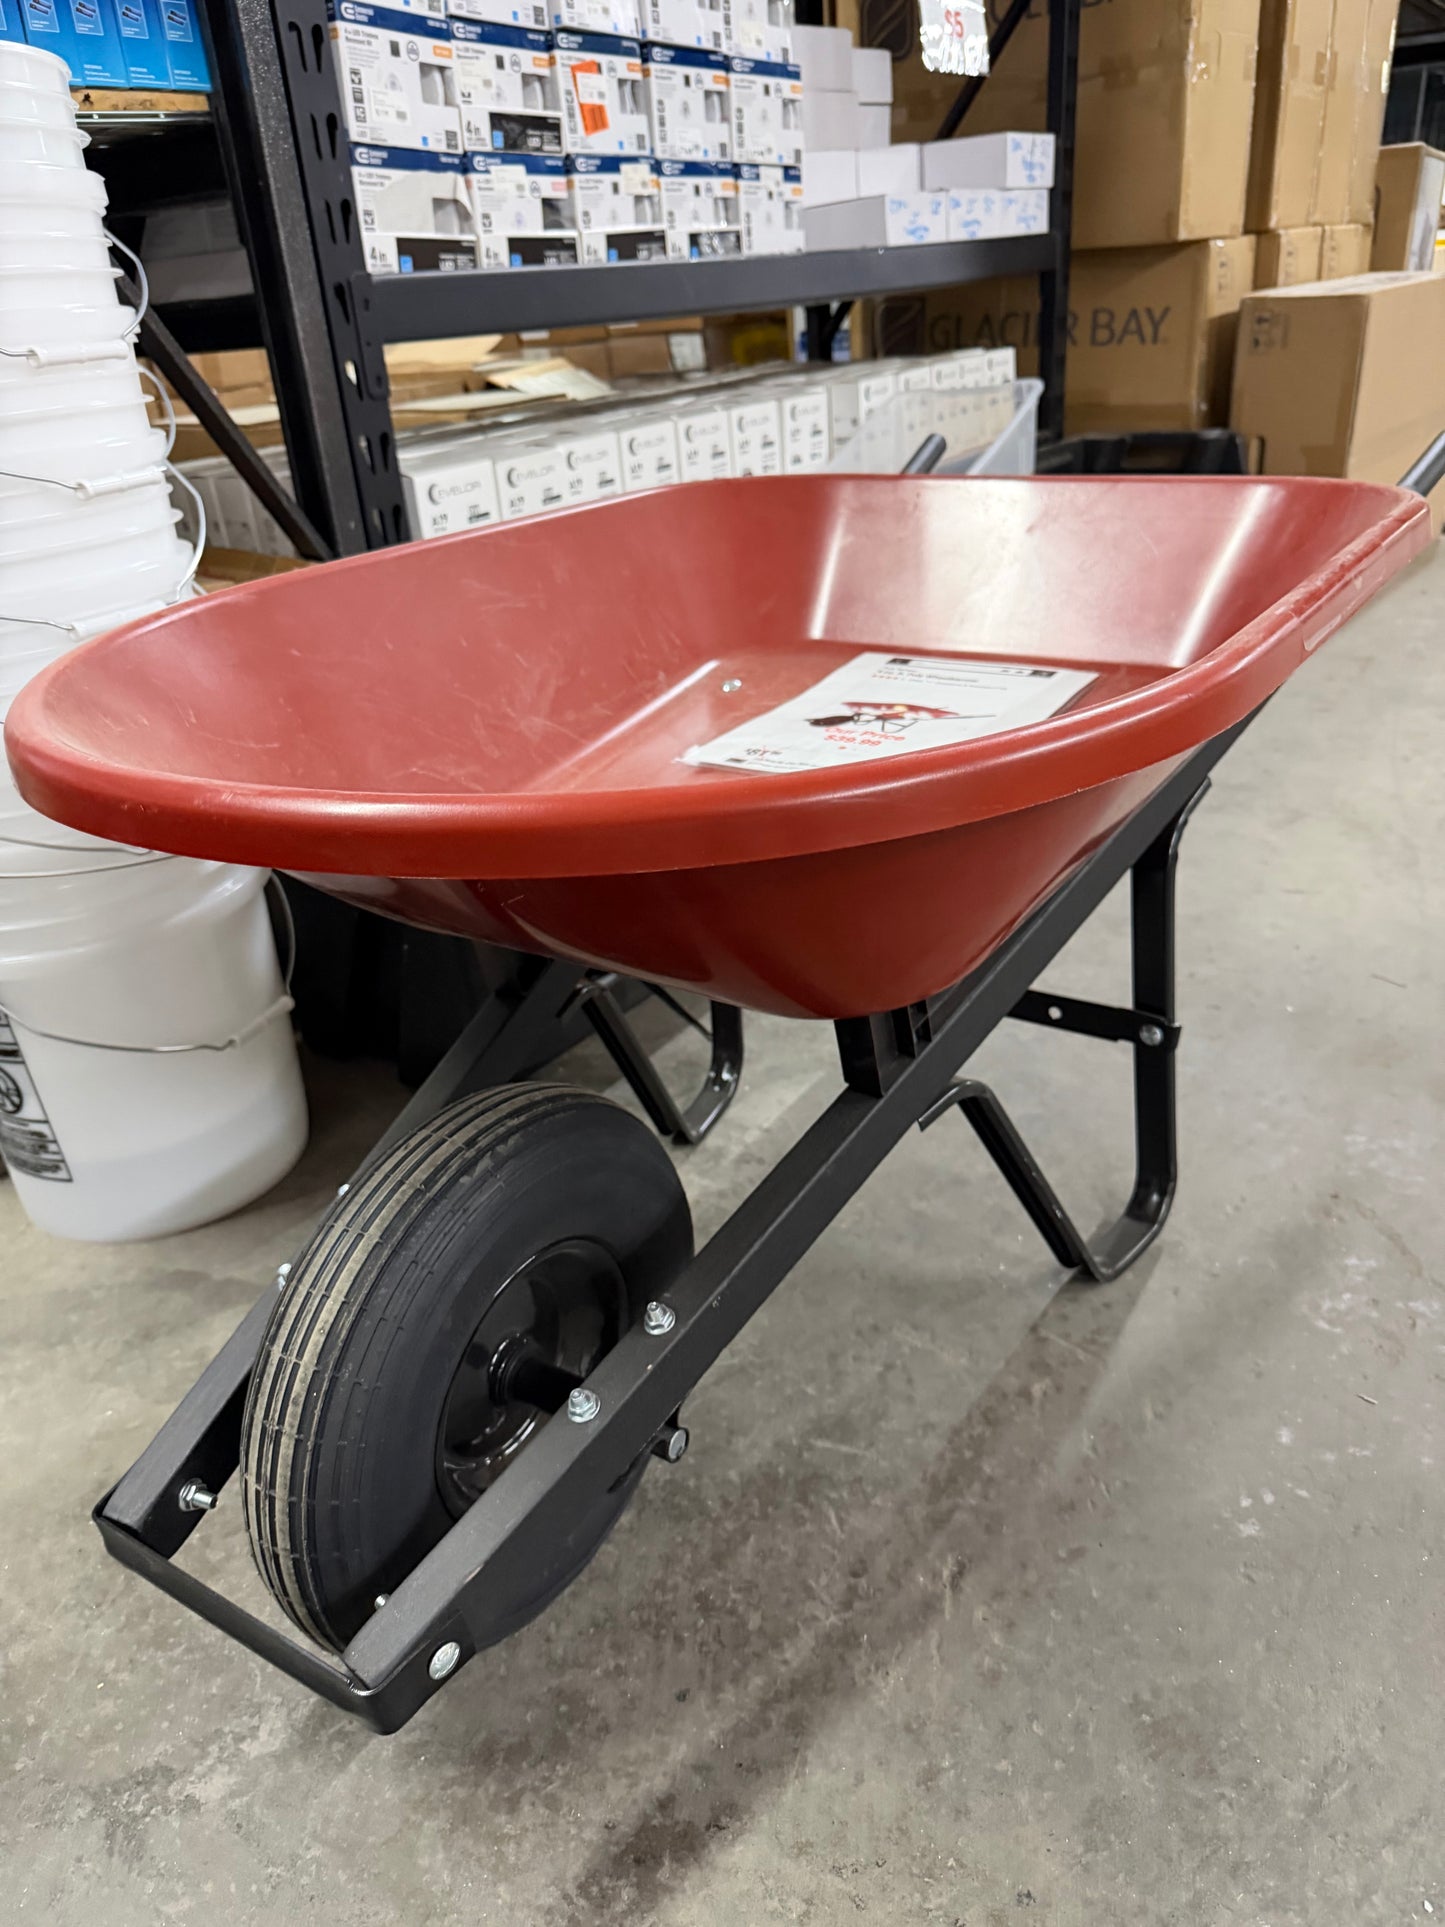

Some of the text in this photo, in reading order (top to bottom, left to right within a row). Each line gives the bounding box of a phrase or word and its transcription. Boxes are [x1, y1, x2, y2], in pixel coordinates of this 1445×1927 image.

[929, 307, 1170, 348] GLACIR BAY
[859, 730, 906, 742] Price
